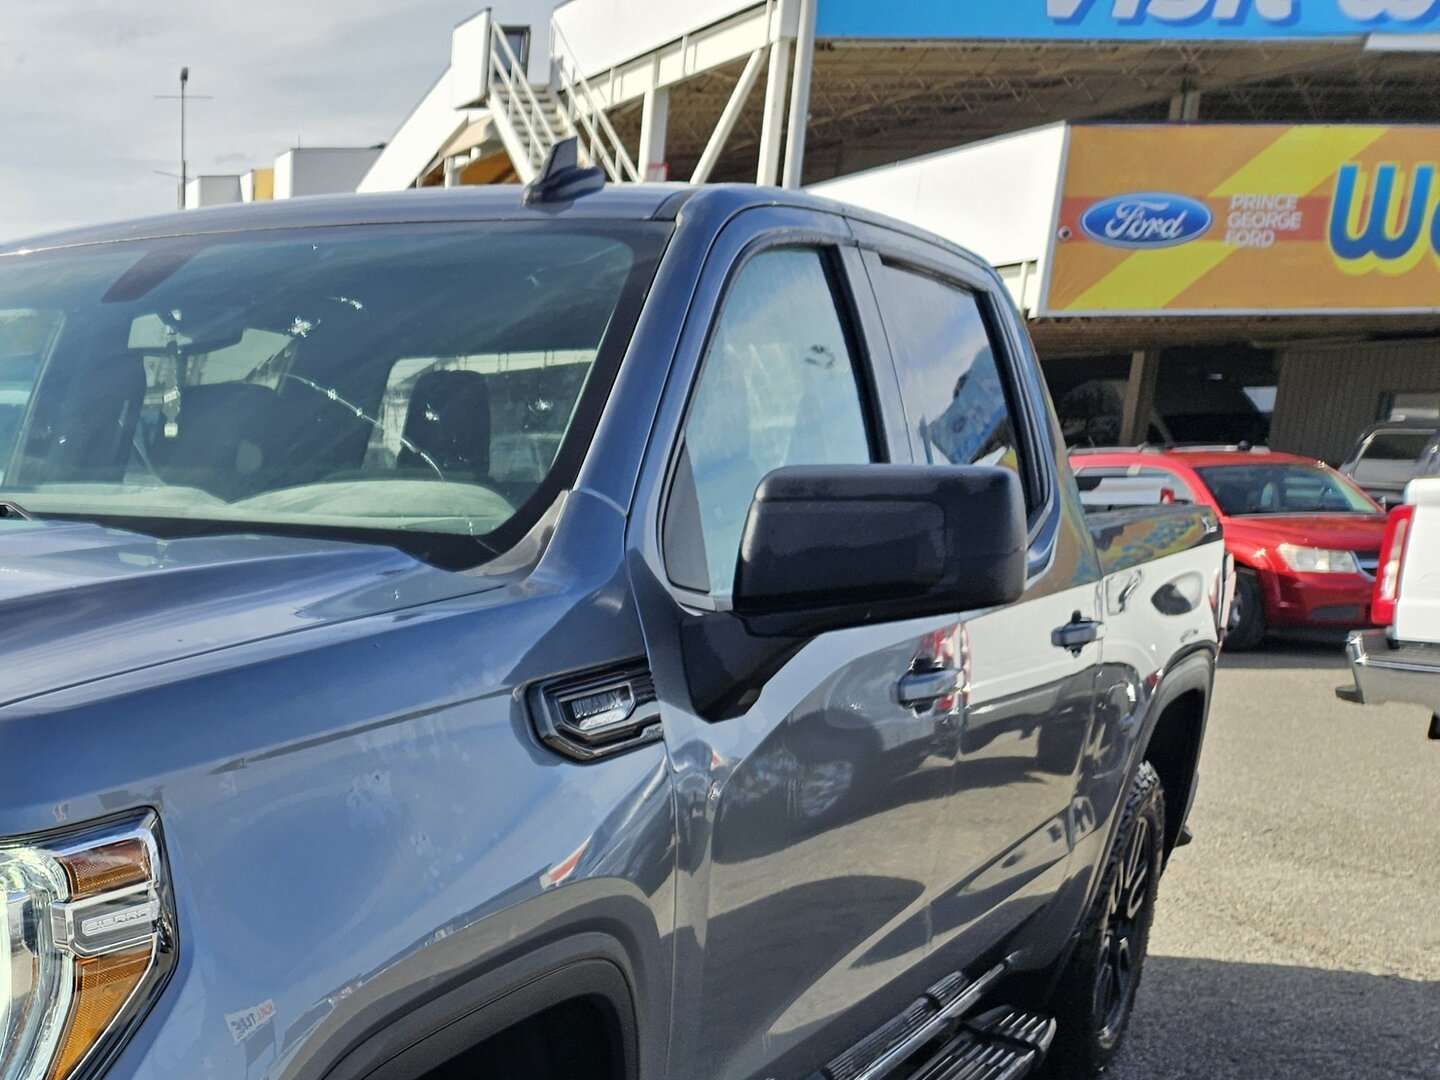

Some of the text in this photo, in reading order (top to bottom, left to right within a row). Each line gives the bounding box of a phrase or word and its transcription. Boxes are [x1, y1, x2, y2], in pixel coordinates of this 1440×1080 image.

[1231, 193, 1298, 210] PRINCE
[1105, 200, 1188, 240] Ford
[1227, 211, 1302, 230] GEORGE
[1223, 229, 1275, 247] FORD
